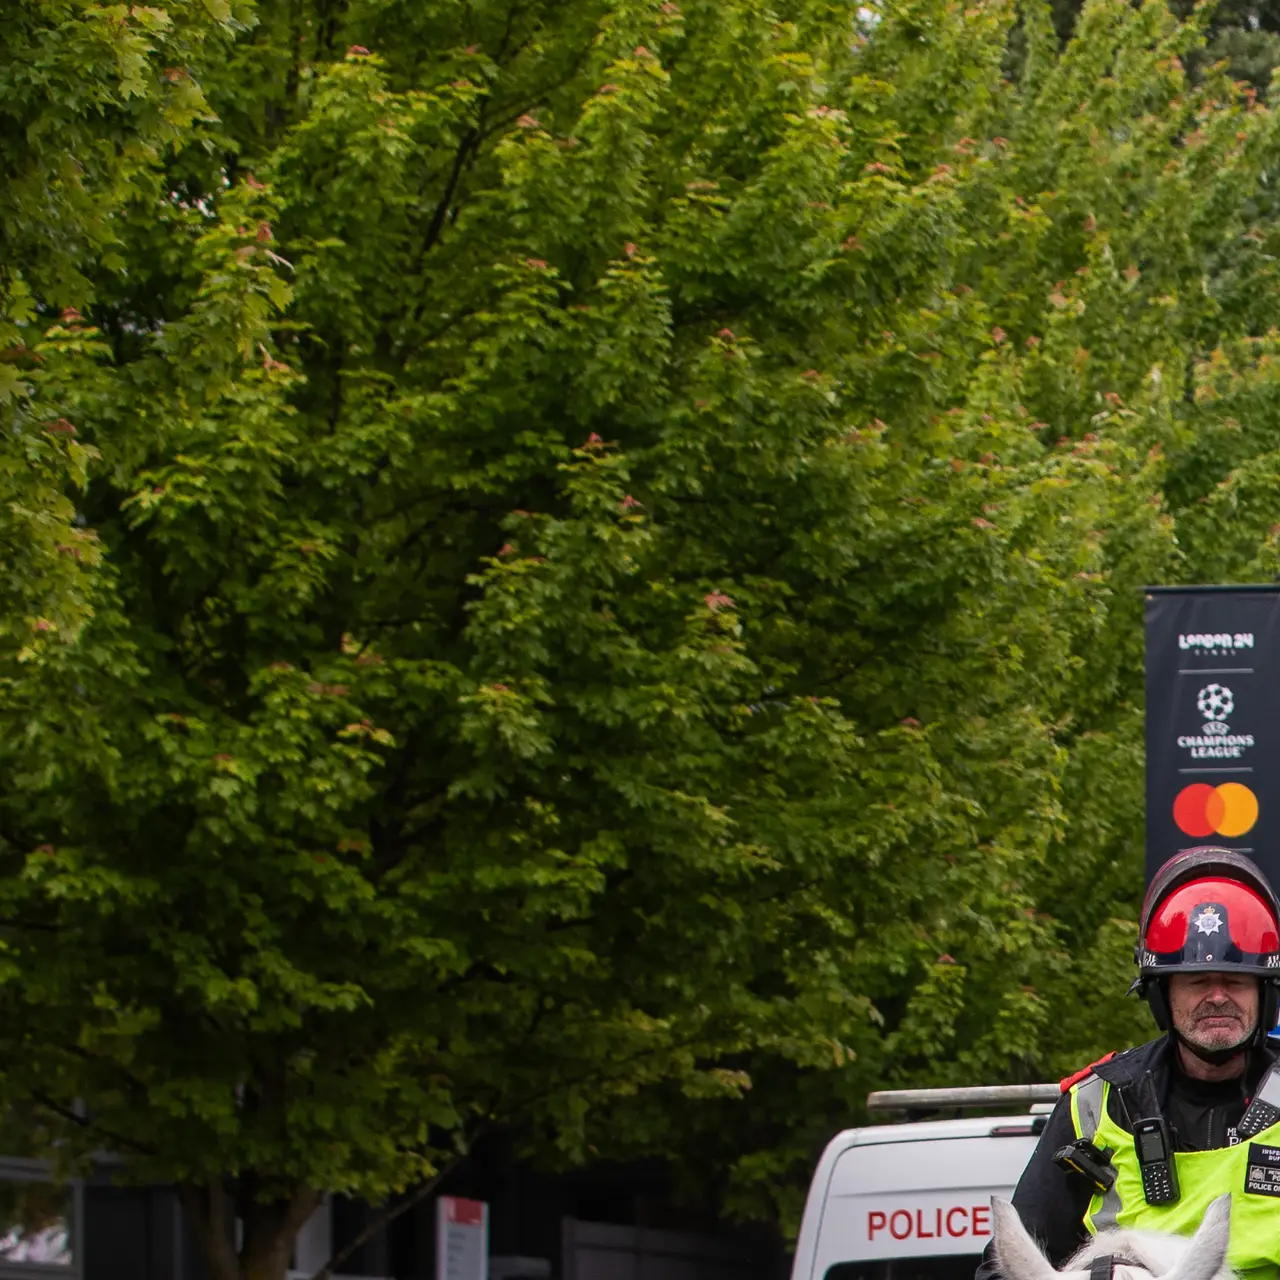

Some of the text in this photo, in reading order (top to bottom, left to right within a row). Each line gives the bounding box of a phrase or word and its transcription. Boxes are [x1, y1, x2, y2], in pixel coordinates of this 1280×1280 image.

[1177, 735, 1255, 748] CHAMPIONS
[1190, 747, 1242, 758] LEAGUE
[1248, 1182, 1272, 1191] POLICE
[867, 1206, 991, 1241] POLICE
